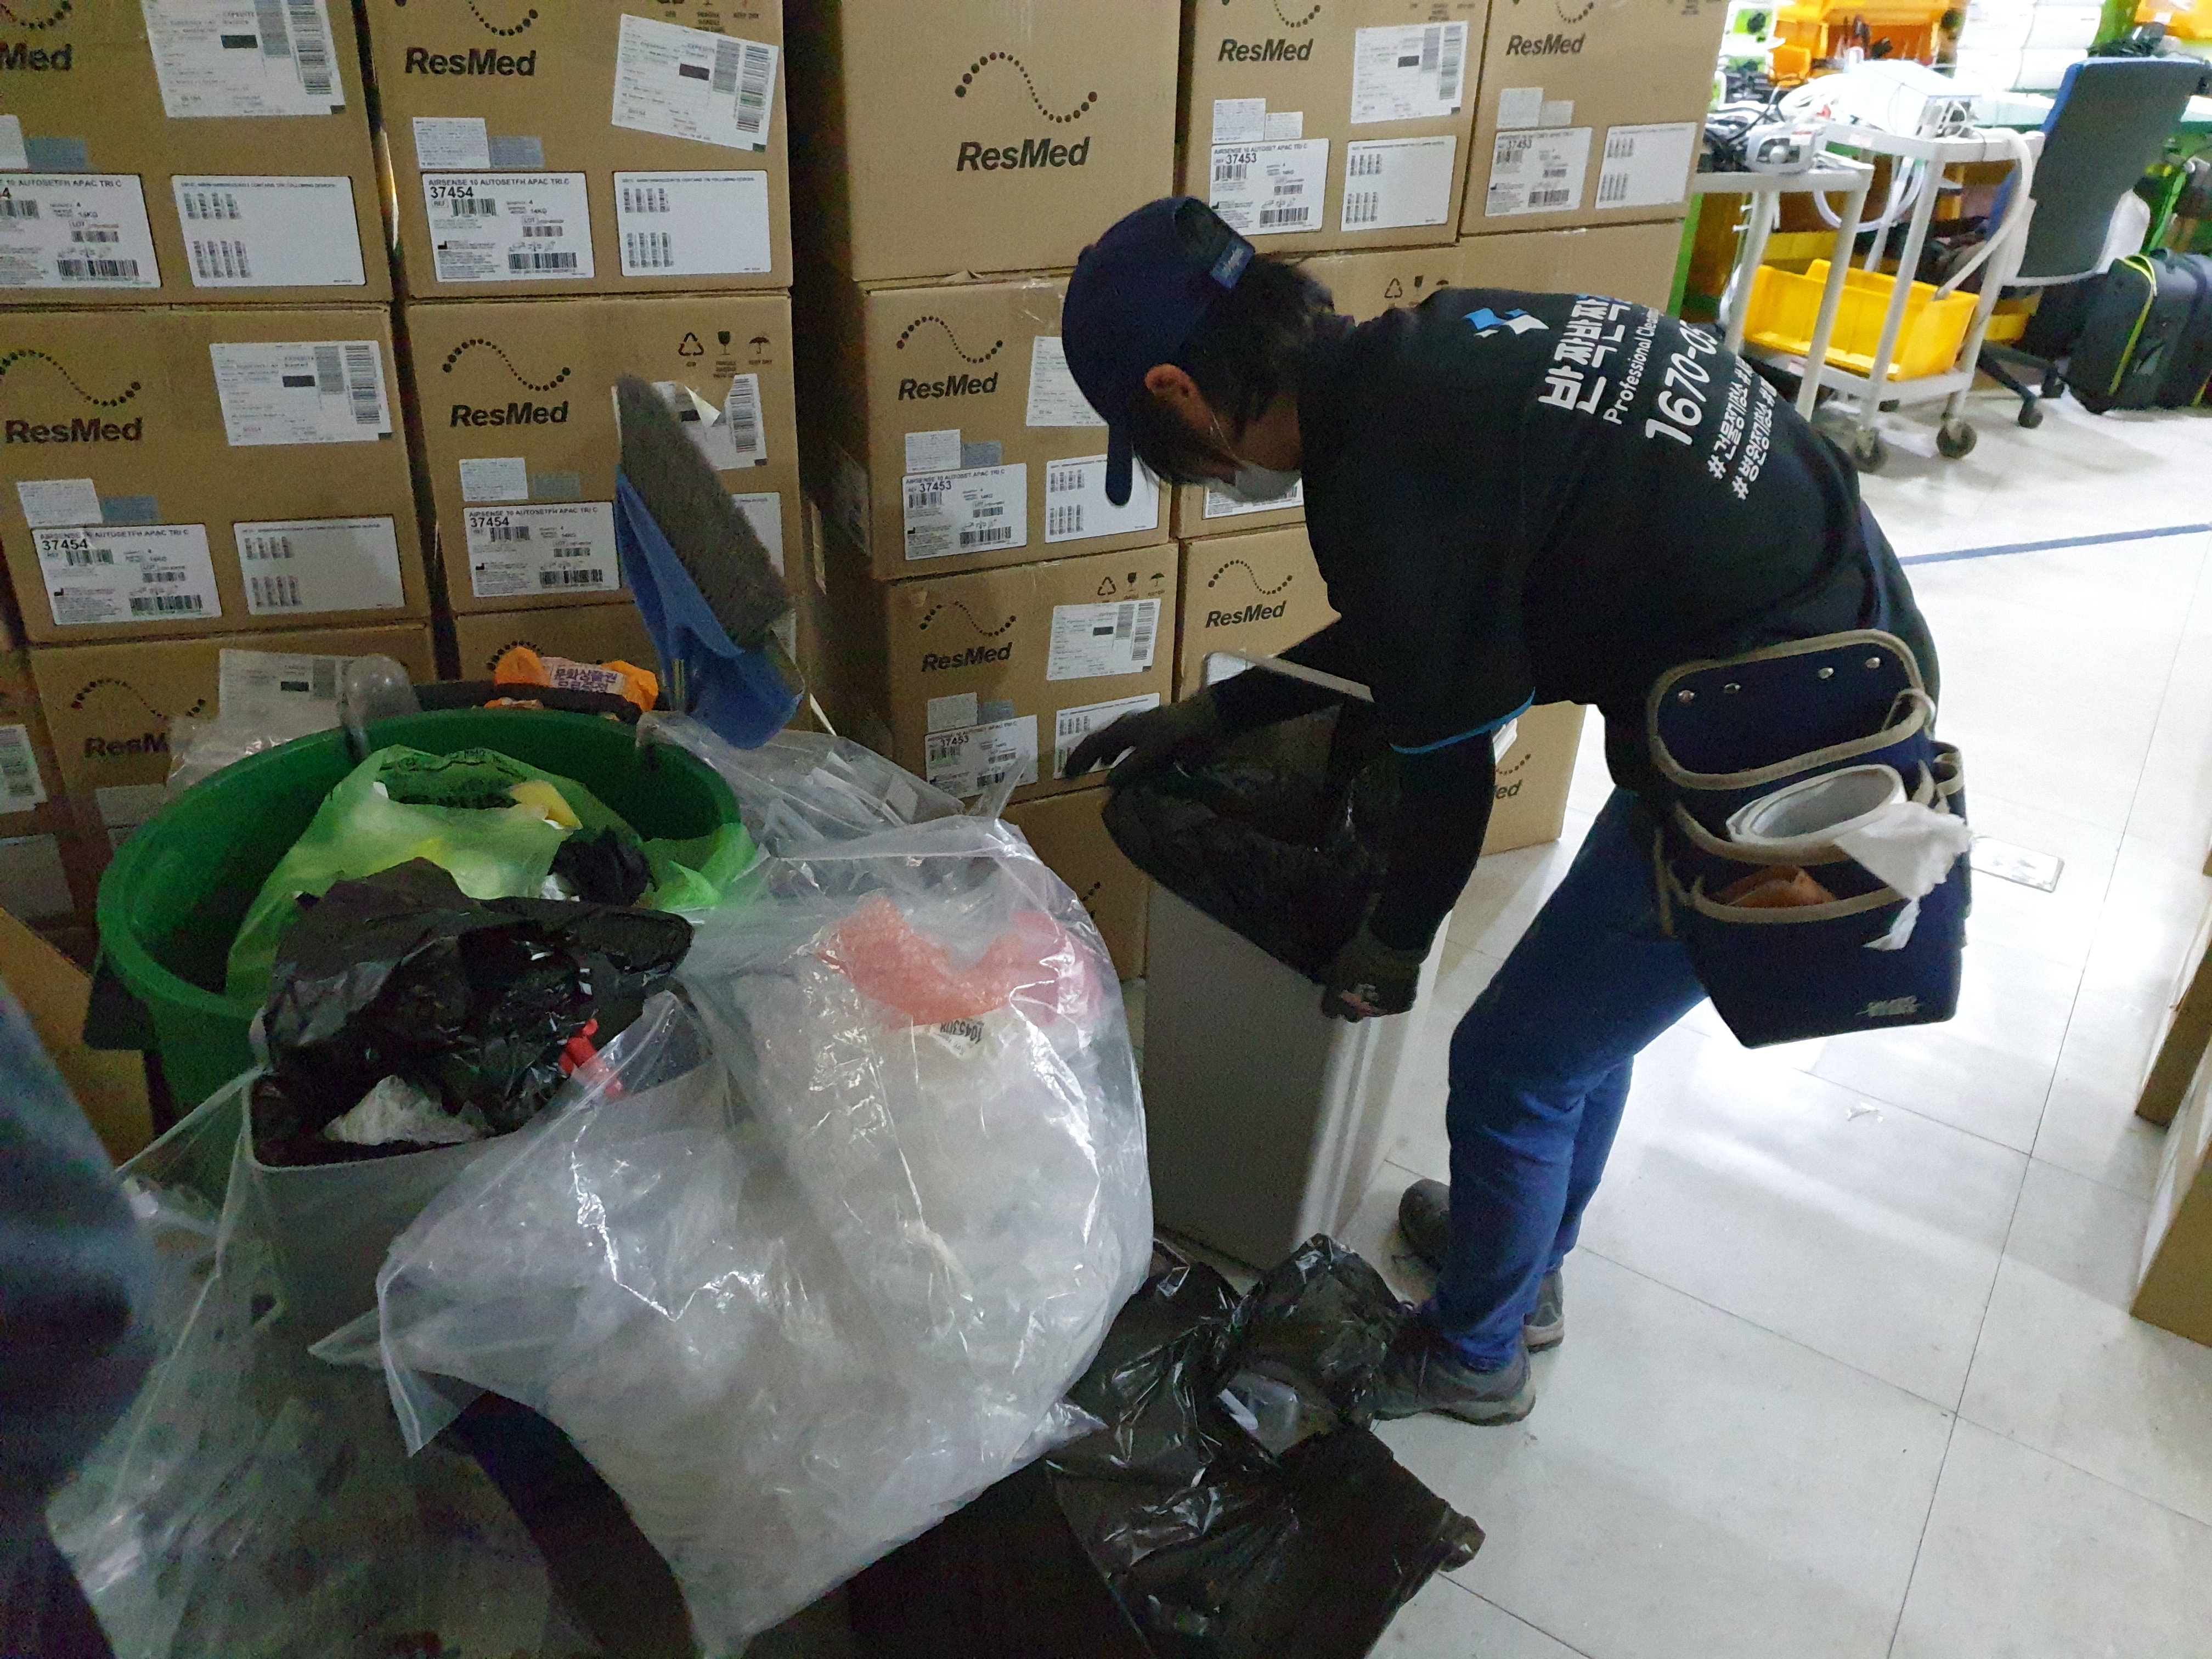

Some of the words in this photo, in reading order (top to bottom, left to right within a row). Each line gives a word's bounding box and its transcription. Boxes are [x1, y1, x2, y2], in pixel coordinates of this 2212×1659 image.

[1218, 38, 1313, 61] ResMed
[1506, 33, 1586, 55] ResMed
[405, 47, 537, 76] ResMed
[957, 136, 1091, 172] ResMed
[1226, 153, 1257, 165] 37453
[431, 187, 474, 198] 37454
[1602, 336, 1652, 425] Professional
[1635, 307, 1660, 337] Clea
[898, 372, 999, 400] ResMed
[449, 401, 568, 427] ResMed
[5, 416, 143, 443] ResMed
[1731, 401, 1773, 500] #병원정기청소
[919, 481, 952, 493] 37453
[470, 517, 510, 528] 37454
[42, 538, 89, 551] 37454
[1205, 601, 1286, 628] ResMed
[921, 642, 1013, 673] ResMed
[1494, 778, 1523, 799] ed
